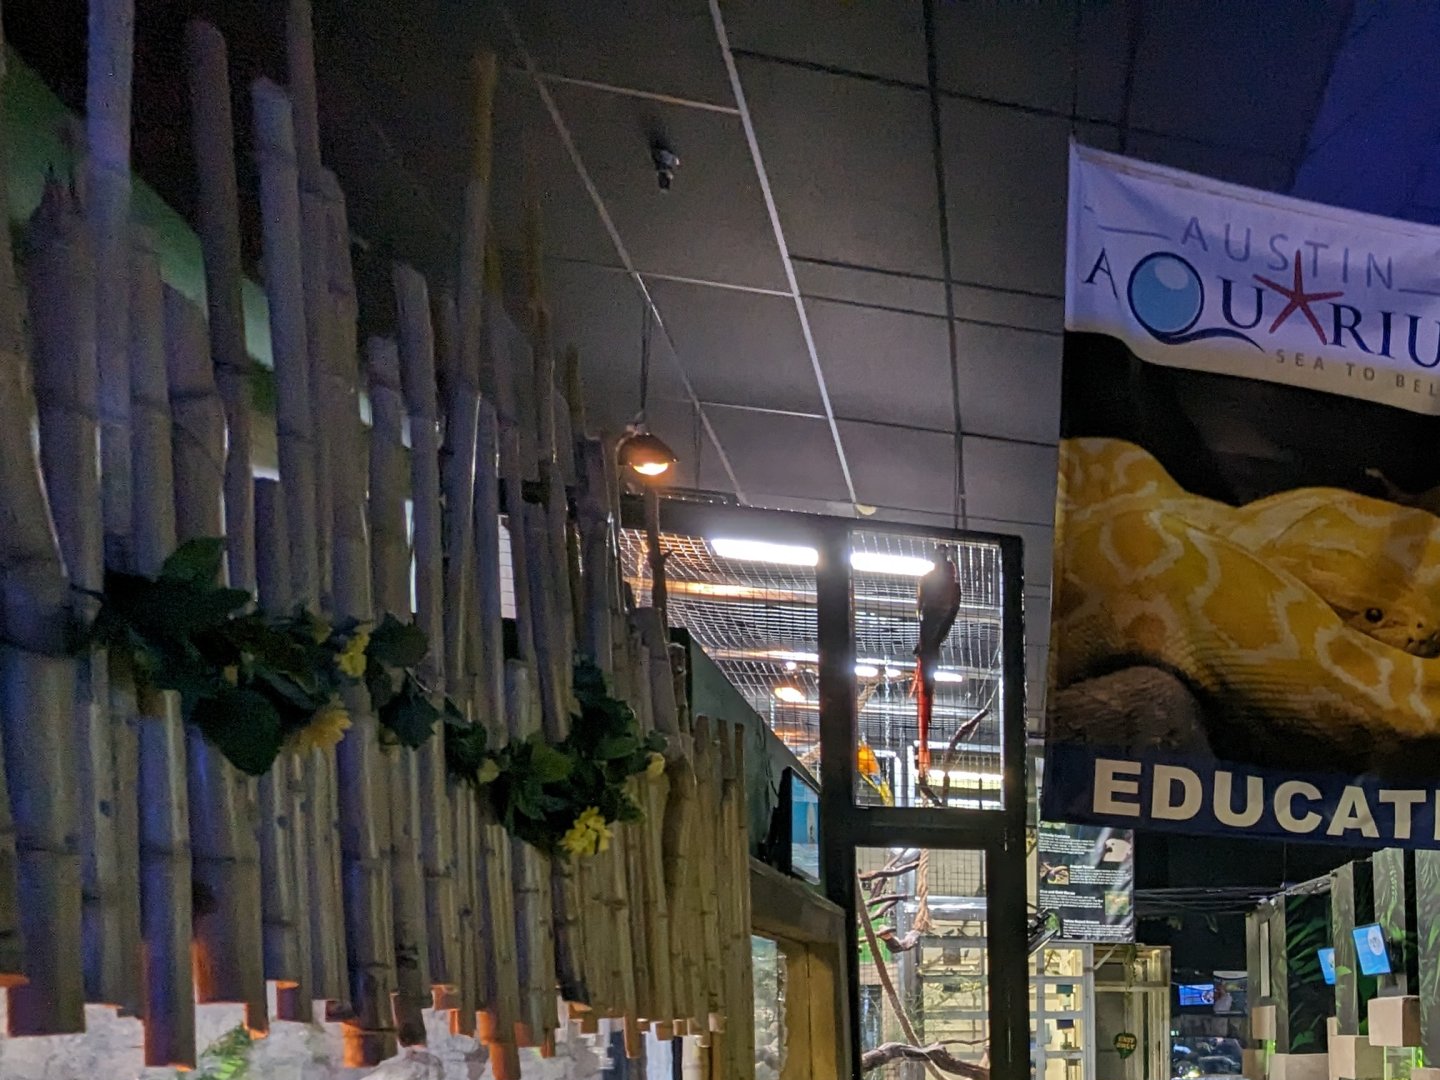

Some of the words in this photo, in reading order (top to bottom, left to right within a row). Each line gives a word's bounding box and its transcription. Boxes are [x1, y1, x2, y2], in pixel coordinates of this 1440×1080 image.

[1181, 216, 1393, 291] AUSTIN
[1275, 348, 1325, 371] SEA
[1345, 361, 1376, 382] TO
